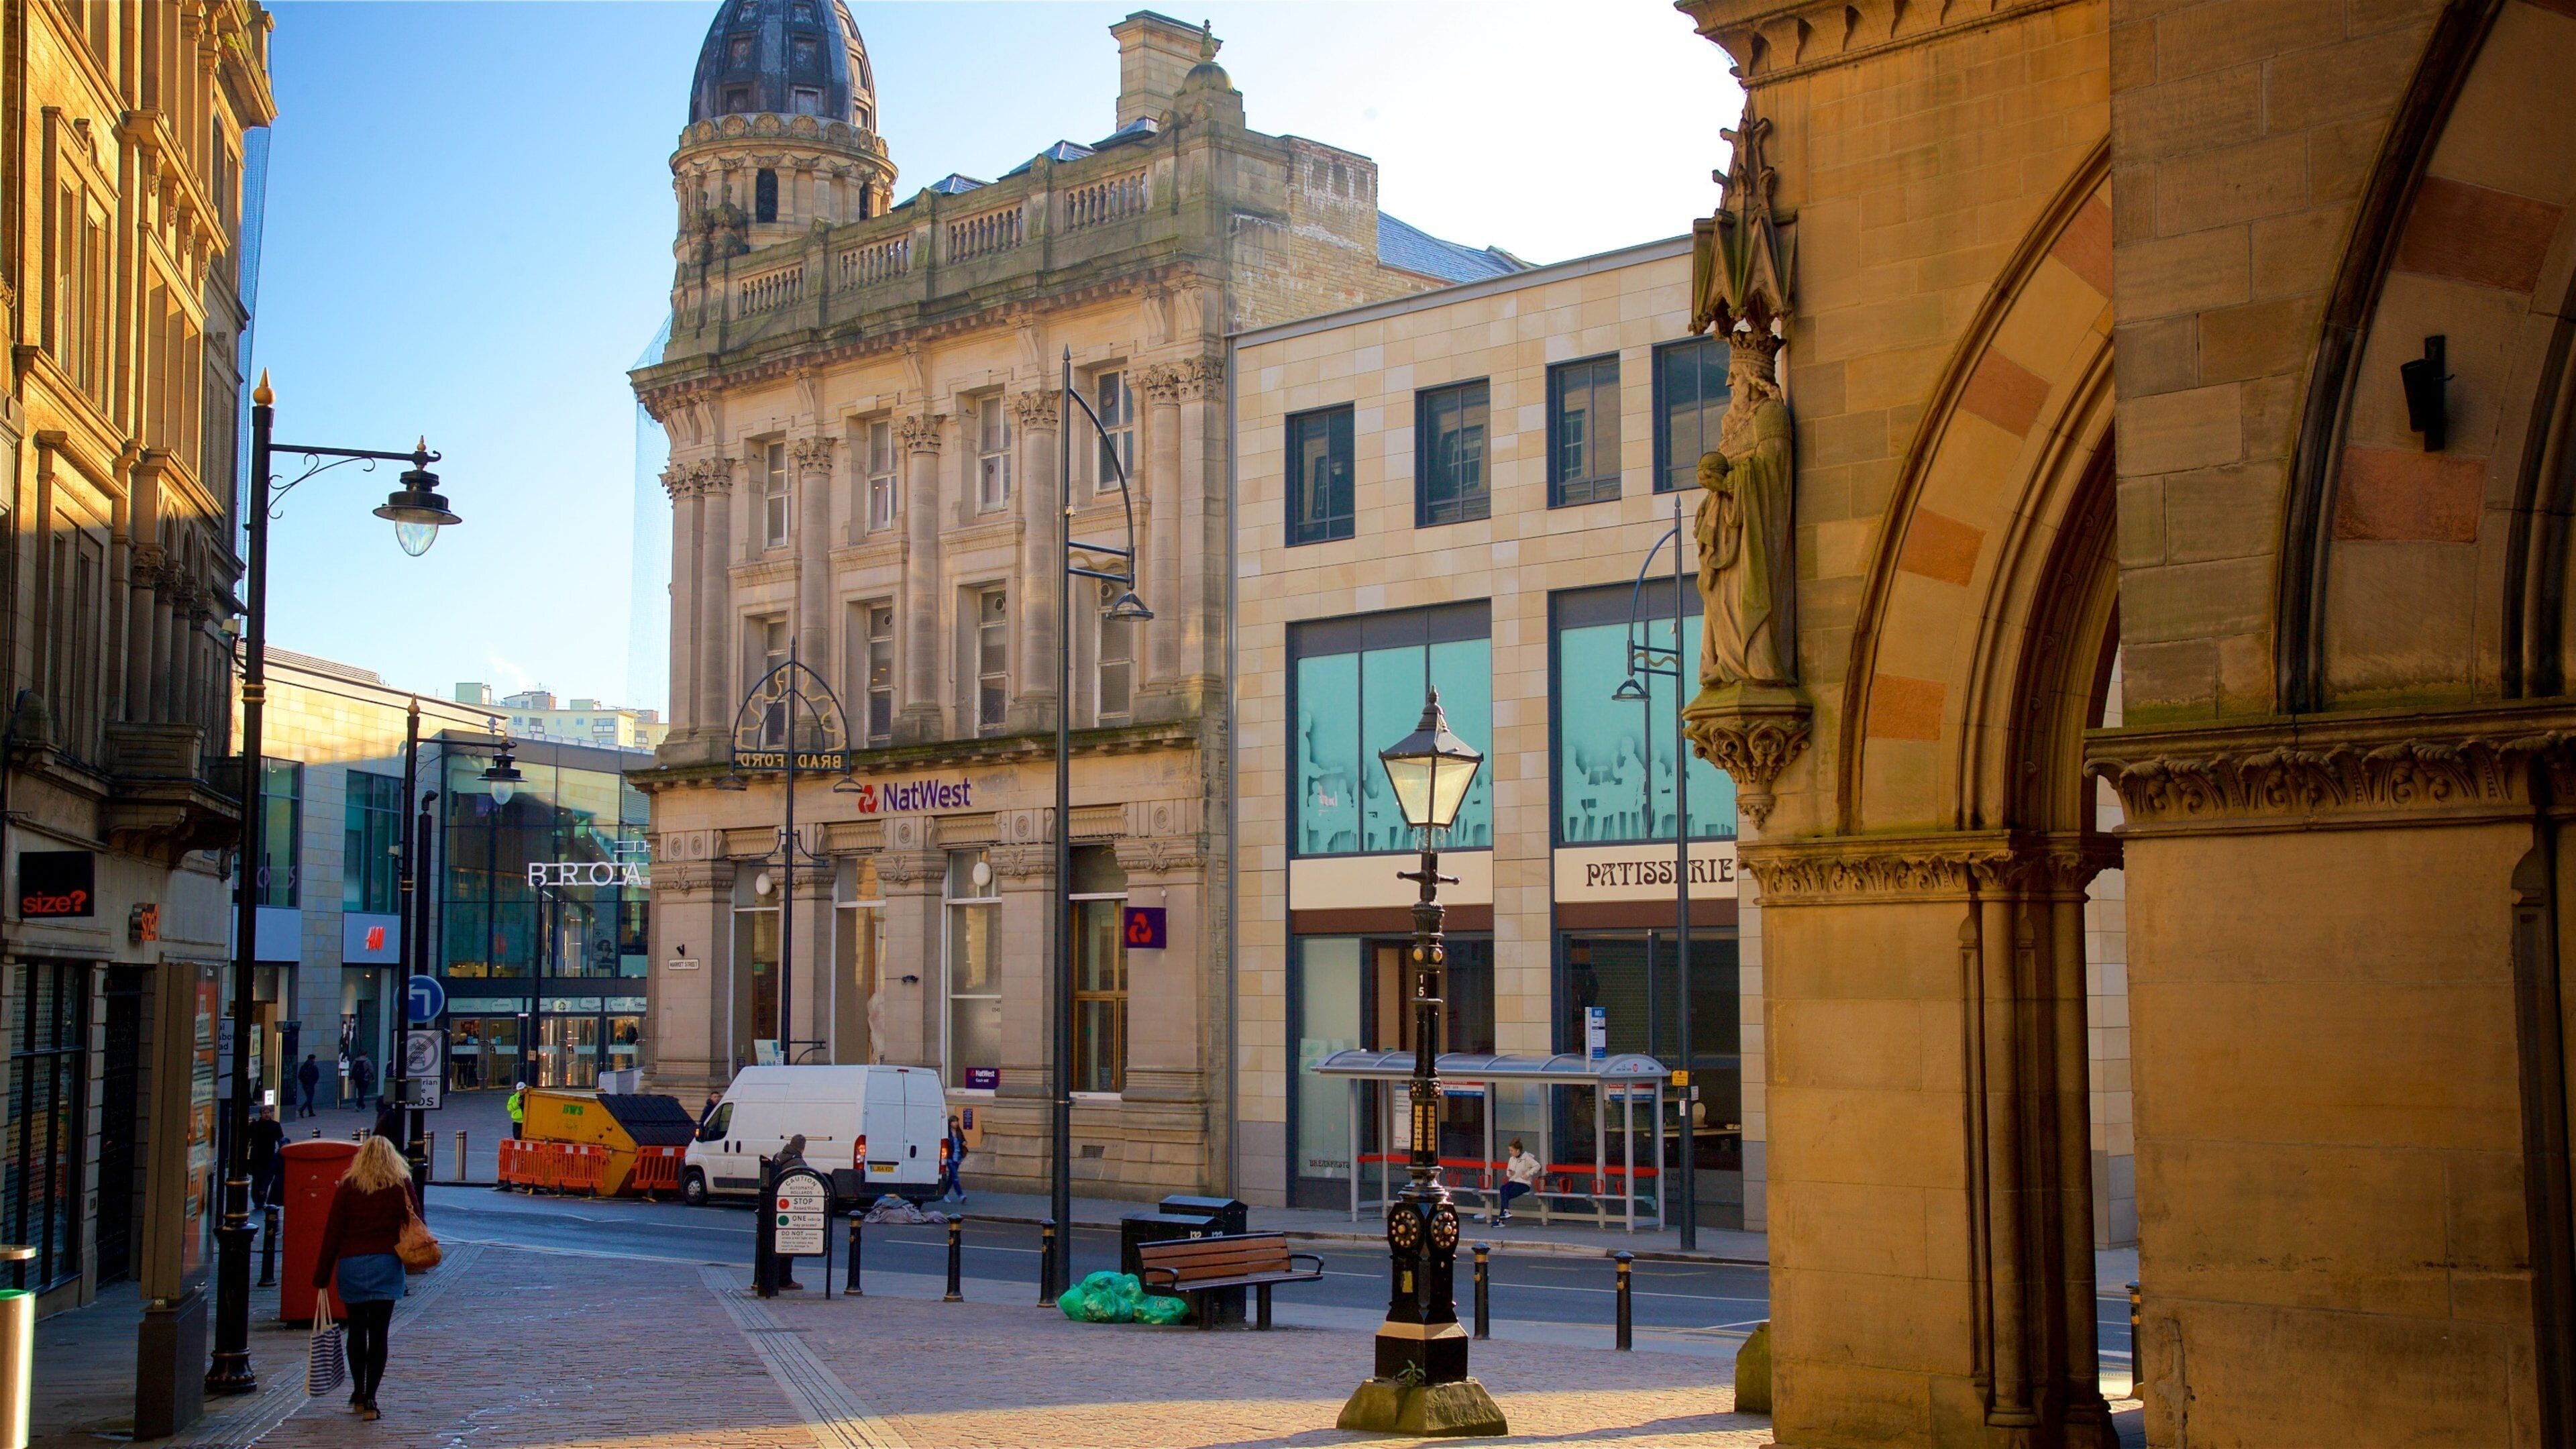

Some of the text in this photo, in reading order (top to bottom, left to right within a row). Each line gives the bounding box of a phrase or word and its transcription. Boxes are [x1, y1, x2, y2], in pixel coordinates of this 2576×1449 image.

[883, 777, 971, 811] NatWest
[23, 890, 87, 914] size?
[975, 1069, 995, 1077] NatWest
[562, 1104, 584, 1116] BWS
[786, 1176, 817, 1186] CAUTION
